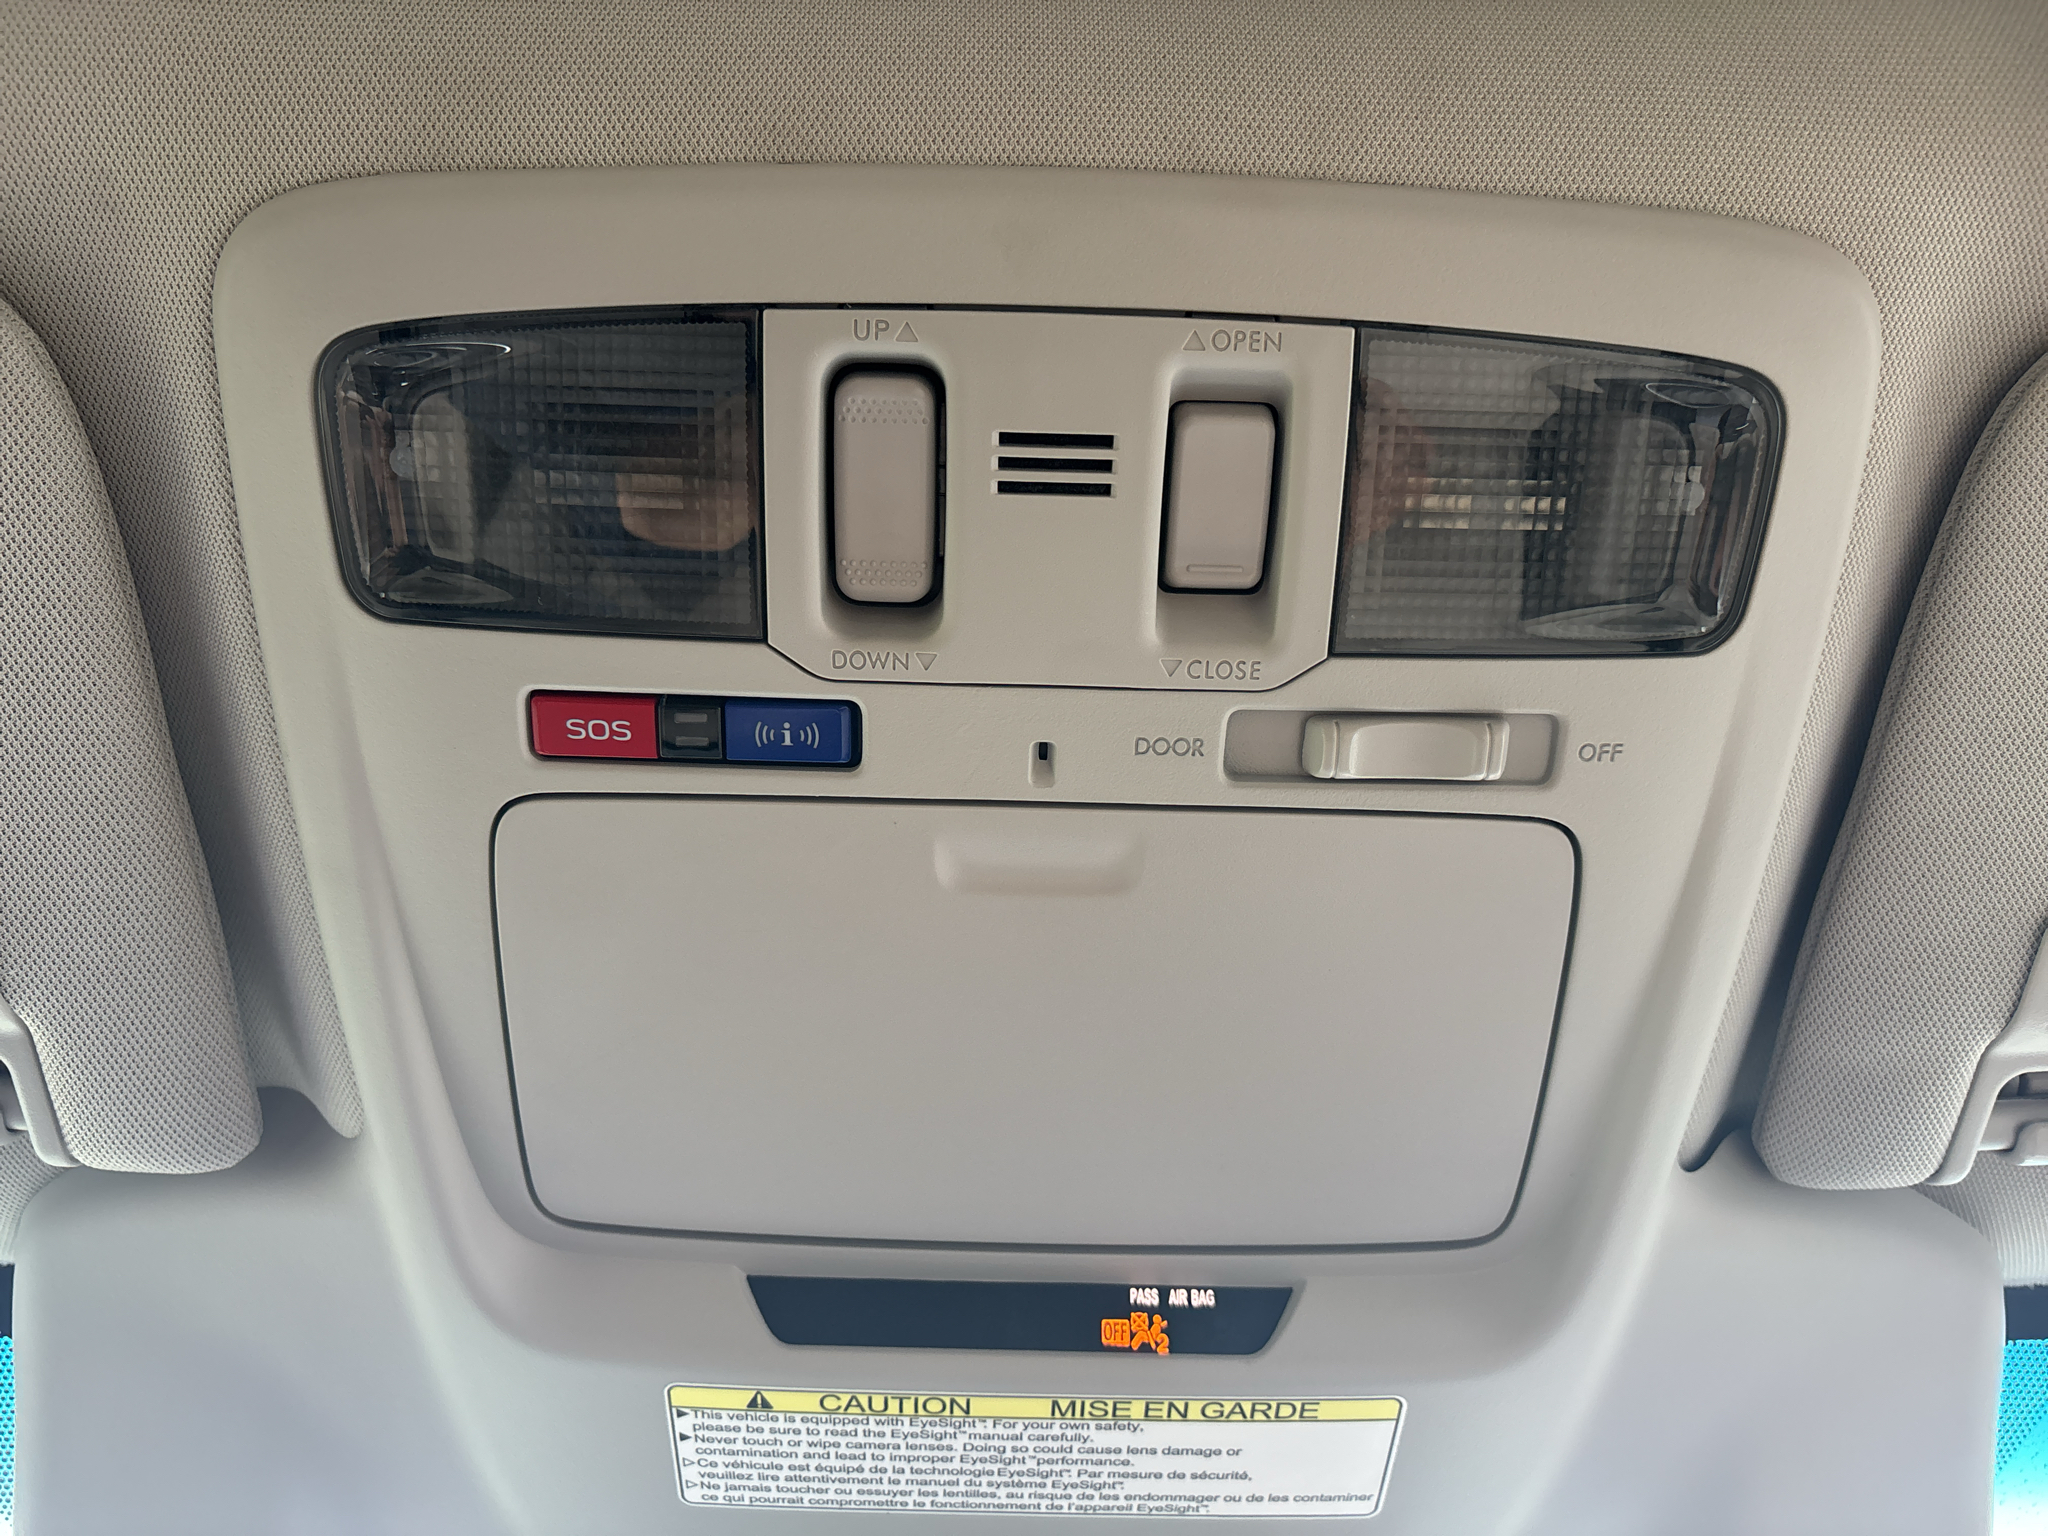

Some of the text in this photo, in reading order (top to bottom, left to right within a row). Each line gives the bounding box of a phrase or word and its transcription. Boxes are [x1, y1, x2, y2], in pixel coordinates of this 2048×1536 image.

[852, 319, 889, 341] UP
[1211, 330, 1282, 353] OPEN
[832, 650, 908, 673] DOWN
[1186, 660, 1261, 681] CLOSE
[566, 719, 631, 741] SOS
[1134, 737, 1204, 756] DOOR
[1578, 743, 1623, 763] OFF
[1130, 1288, 1215, 1308] PASS AIR BAG
[1104, 1321, 1127, 1340] OFF
[819, 1394, 970, 1415] CAUTION
[1051, 1400, 1320, 1419] MISE EN GARDE
[691, 1410, 722, 1420] This
[727, 1412, 779, 1423] vehicle
[784, 1413, 795, 1423] is
[801, 1415, 869, 1427] equipped
[875, 1417, 904, 1426] with
[993, 1420, 1018, 1429] For
[1022, 1422, 1056, 1431] your
[1095, 1422, 1143, 1432] safety,
[693, 1423, 741, 1433] please
[747, 1425, 764, 1434] be
[769, 1426, 801, 1435] sure
[806, 1426, 820, 1436] to
[825, 1427, 857, 1437] read
[863, 1428, 886, 1438] the
[969, 1431, 1023, 1441] manual
[1028, 1433, 1093, 1443] carefully.
[695, 1434, 1242, 1457] Never touch or wipe camera lenses. Doing so could cause lens damage or
[695, 1445, 798, 1458] contamination
[803, 1449, 830, 1460] and
[835, 1450, 866, 1460] lead
[871, 1451, 885, 1461] to
[890, 1452, 955, 1464] improper
[1037, 1455, 1134, 1466] performance.
[697, 1458, 718, 1468] Ce
[723, 1459, 783, 1470] véhicule
[788, 1462, 810, 1471] est
[815, 1462, 864, 1474] équipé
[869, 1464, 888, 1474] de
[893, 1464, 904, 1474] la
[910, 1466, 995, 1478] technologie
[1077, 1469, 1103, 1478] Par
[1108, 1470, 1162, 1479] mesure
[1167, 1470, 1186, 1480] de
[1191, 1470, 1252, 1481] sécurité,
[699, 1470, 753, 1481] veuillez
[758, 1472, 780, 1482] lire
[784, 1473, 883, 1485] attentivement
[888, 1475, 901, 1485] le
[906, 1477, 959, 1486] manuel
[964, 1478, 982, 1487] du
[987, 1478, 1047, 1489] système
[701, 1481, 1373, 1503] Ne jamais toucher ou essuyer les lentilles, au risque de les endommager ou de les contaminer
[723, 1494, 744, 1505] qui
[749, 1494, 803, 1506] pourrait
[809, 1497, 908, 1507] compromettre
[913, 1499, 925, 1507] le
[930, 1499, 1041, 1510] fonctionnement
[1045, 1501, 1063, 1511] de
